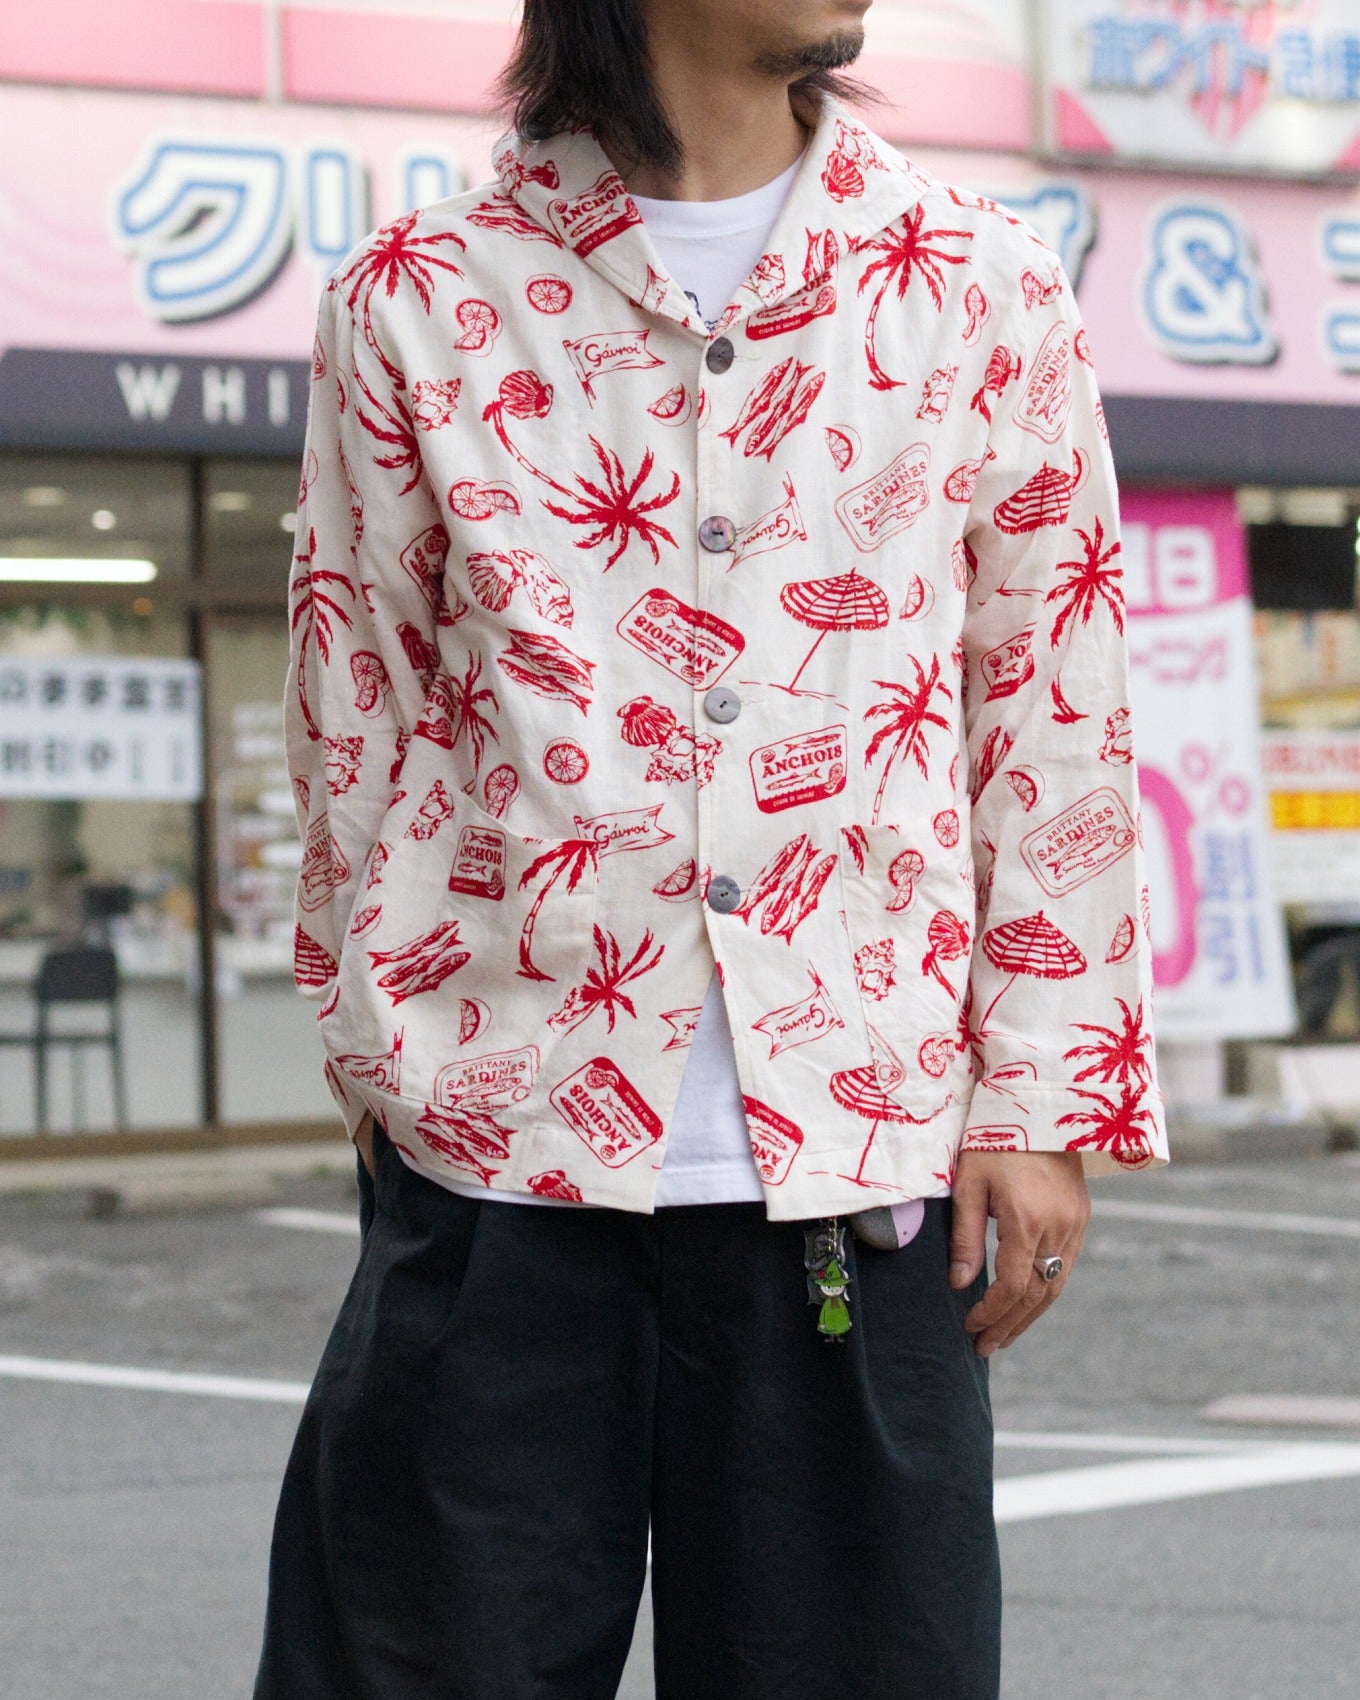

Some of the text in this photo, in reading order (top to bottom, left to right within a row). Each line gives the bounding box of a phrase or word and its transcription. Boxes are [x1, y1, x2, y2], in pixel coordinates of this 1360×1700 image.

[1147, 204, 1273, 352] &
[852, 461, 928, 520] SARDINES
[862, 462, 907, 501] BRITTANY
[762, 745, 842, 779] ANCHOIS
[1036, 806, 1114, 861] SARDINES
[1046, 808, 1092, 841] BRITTANY
[446, 1060, 527, 1090] SARDINES
[569, 1084, 632, 1151] ANCHOIS
